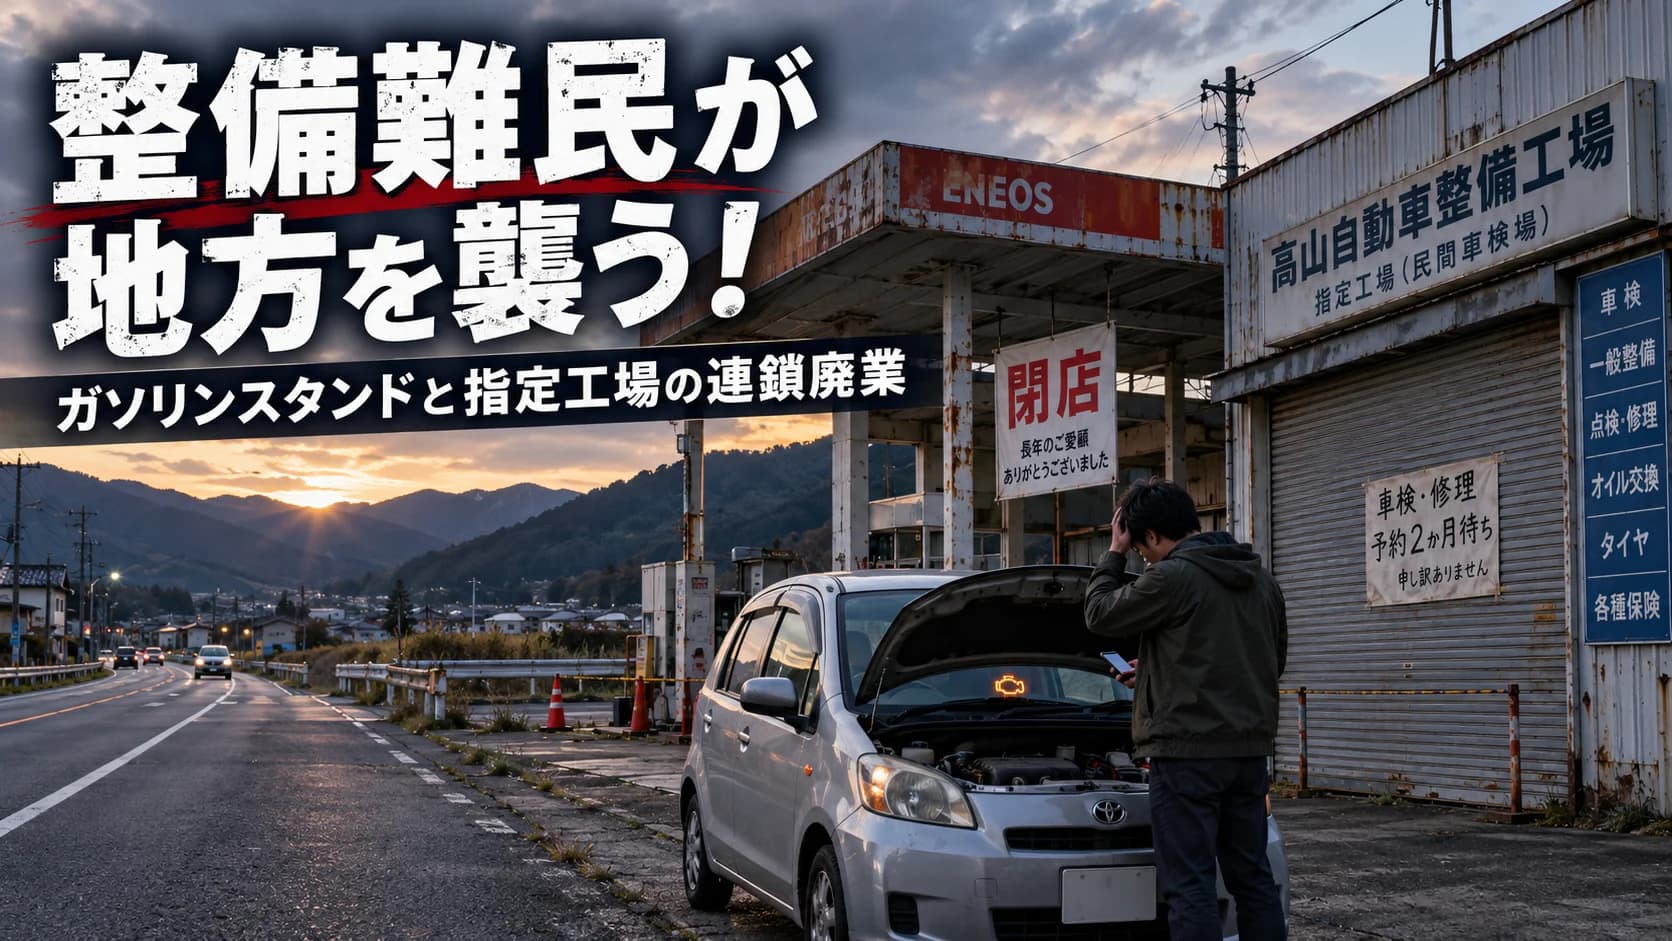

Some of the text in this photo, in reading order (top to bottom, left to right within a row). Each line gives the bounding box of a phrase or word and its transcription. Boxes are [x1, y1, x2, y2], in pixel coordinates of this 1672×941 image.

[943, 173, 1054, 215] ENEOS
[1271, 102, 1615, 293] 高山自動車整備工場
[1589, 337, 1657, 376] 一般整備
[1007, 347, 1102, 430] 閉店
[1590, 400, 1659, 440] 点検・修理
[1003, 450, 1110, 485] ありがとうございました
[1591, 463, 1660, 500] オイル交換
[1377, 469, 1477, 521] 車検・修理
[1600, 527, 1650, 560] タイヤ
[1398, 559, 1489, 591] 申し訳ありません
[1594, 589, 1661, 622] 各種保険
